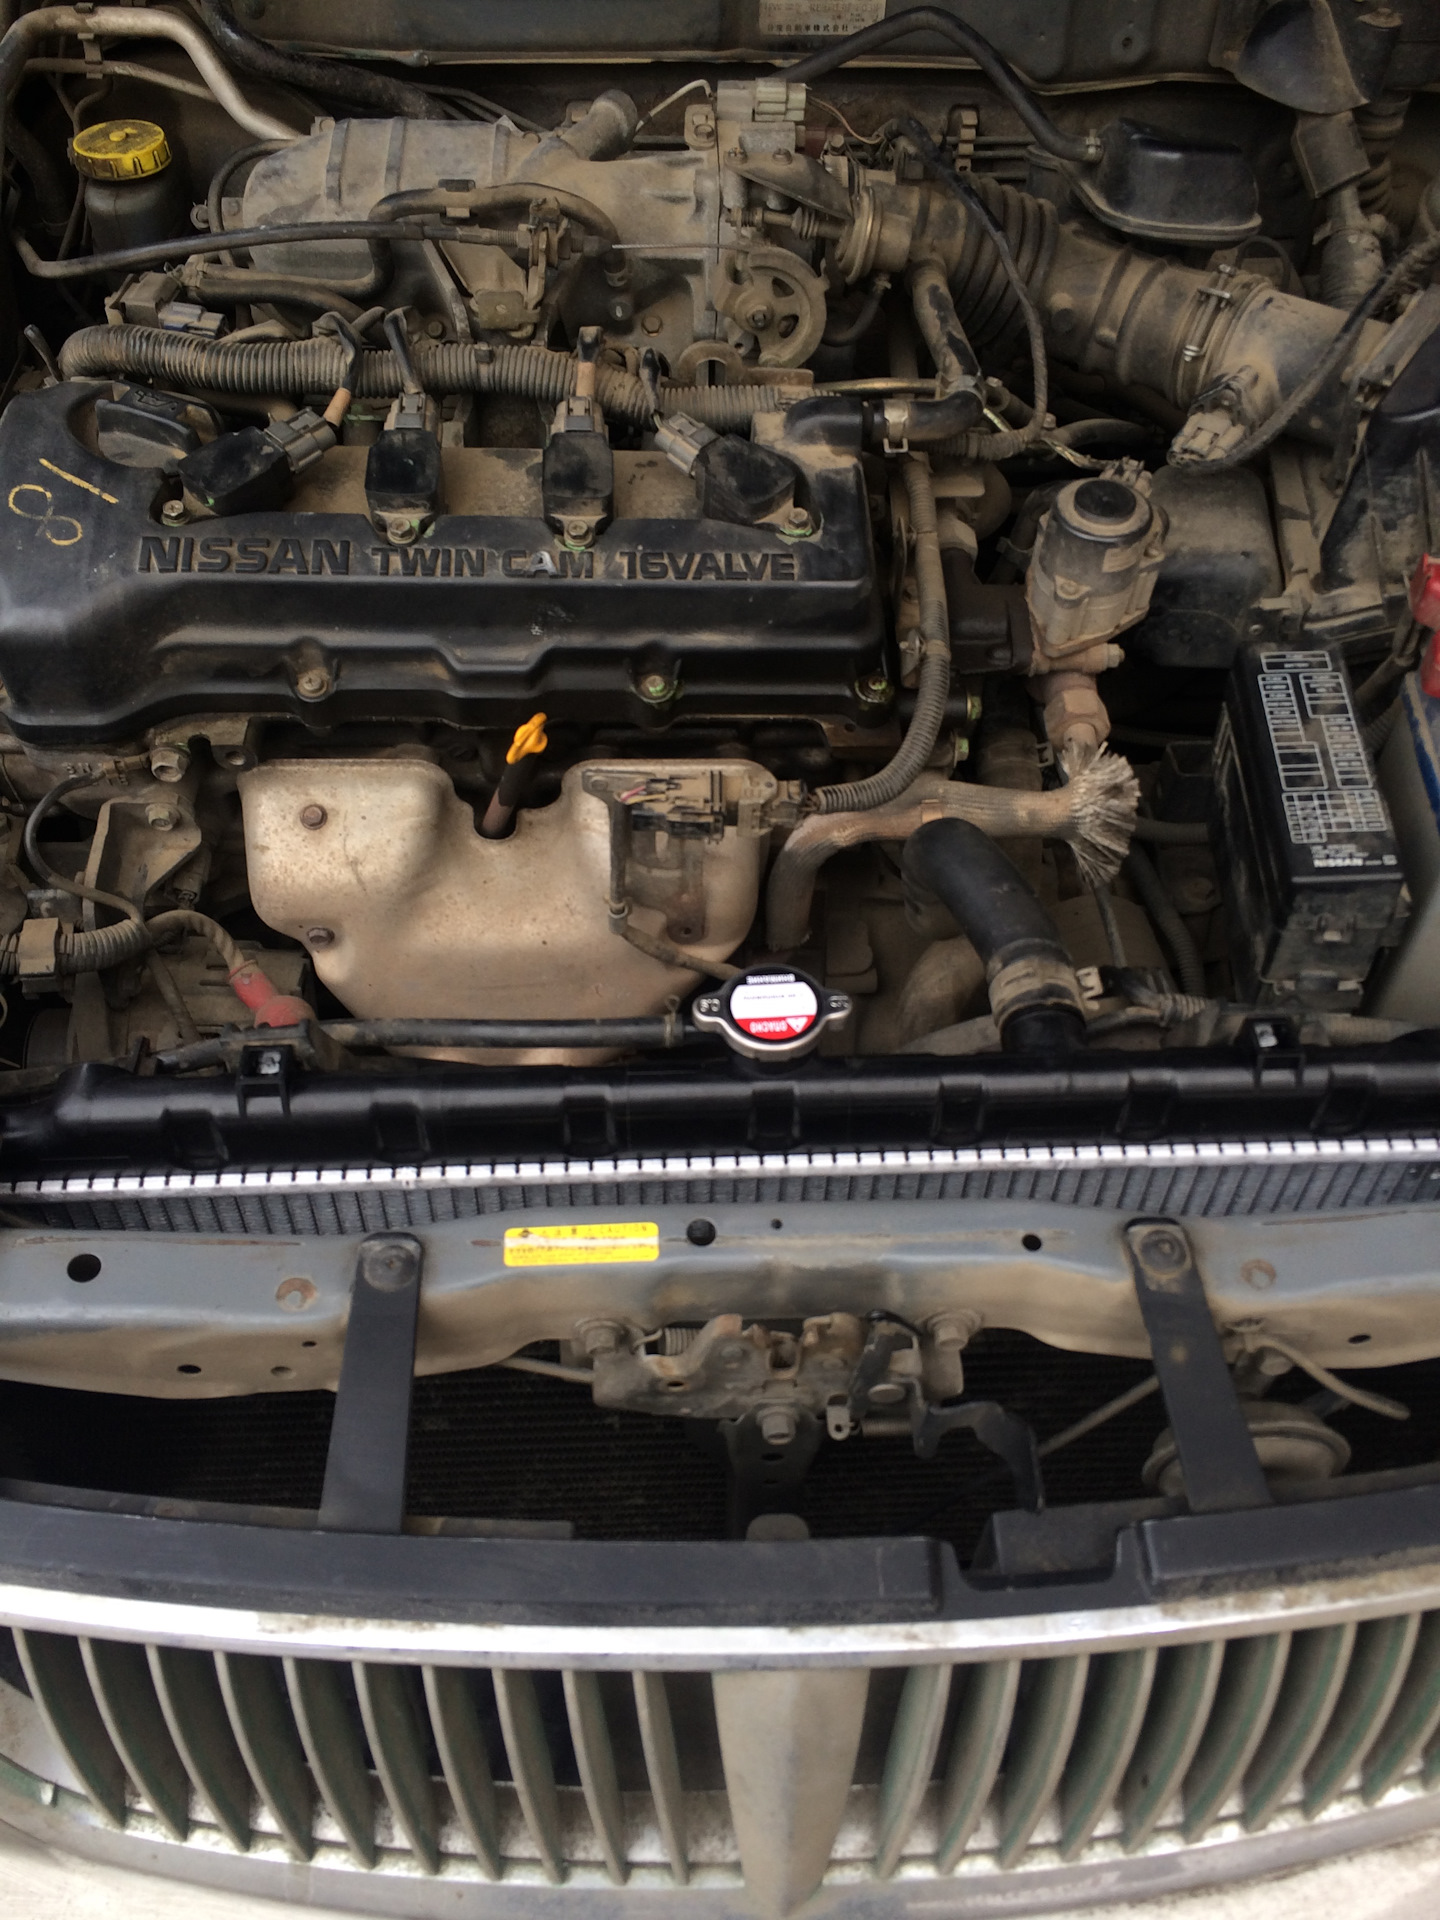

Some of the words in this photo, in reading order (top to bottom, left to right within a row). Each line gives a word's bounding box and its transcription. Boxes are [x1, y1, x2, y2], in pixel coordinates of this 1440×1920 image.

[138, 535, 350, 575] NISSAN
[371, 547, 485, 577] TWIN
[502, 551, 594, 579] CAM
[618, 551, 796, 580] 16VALVE
